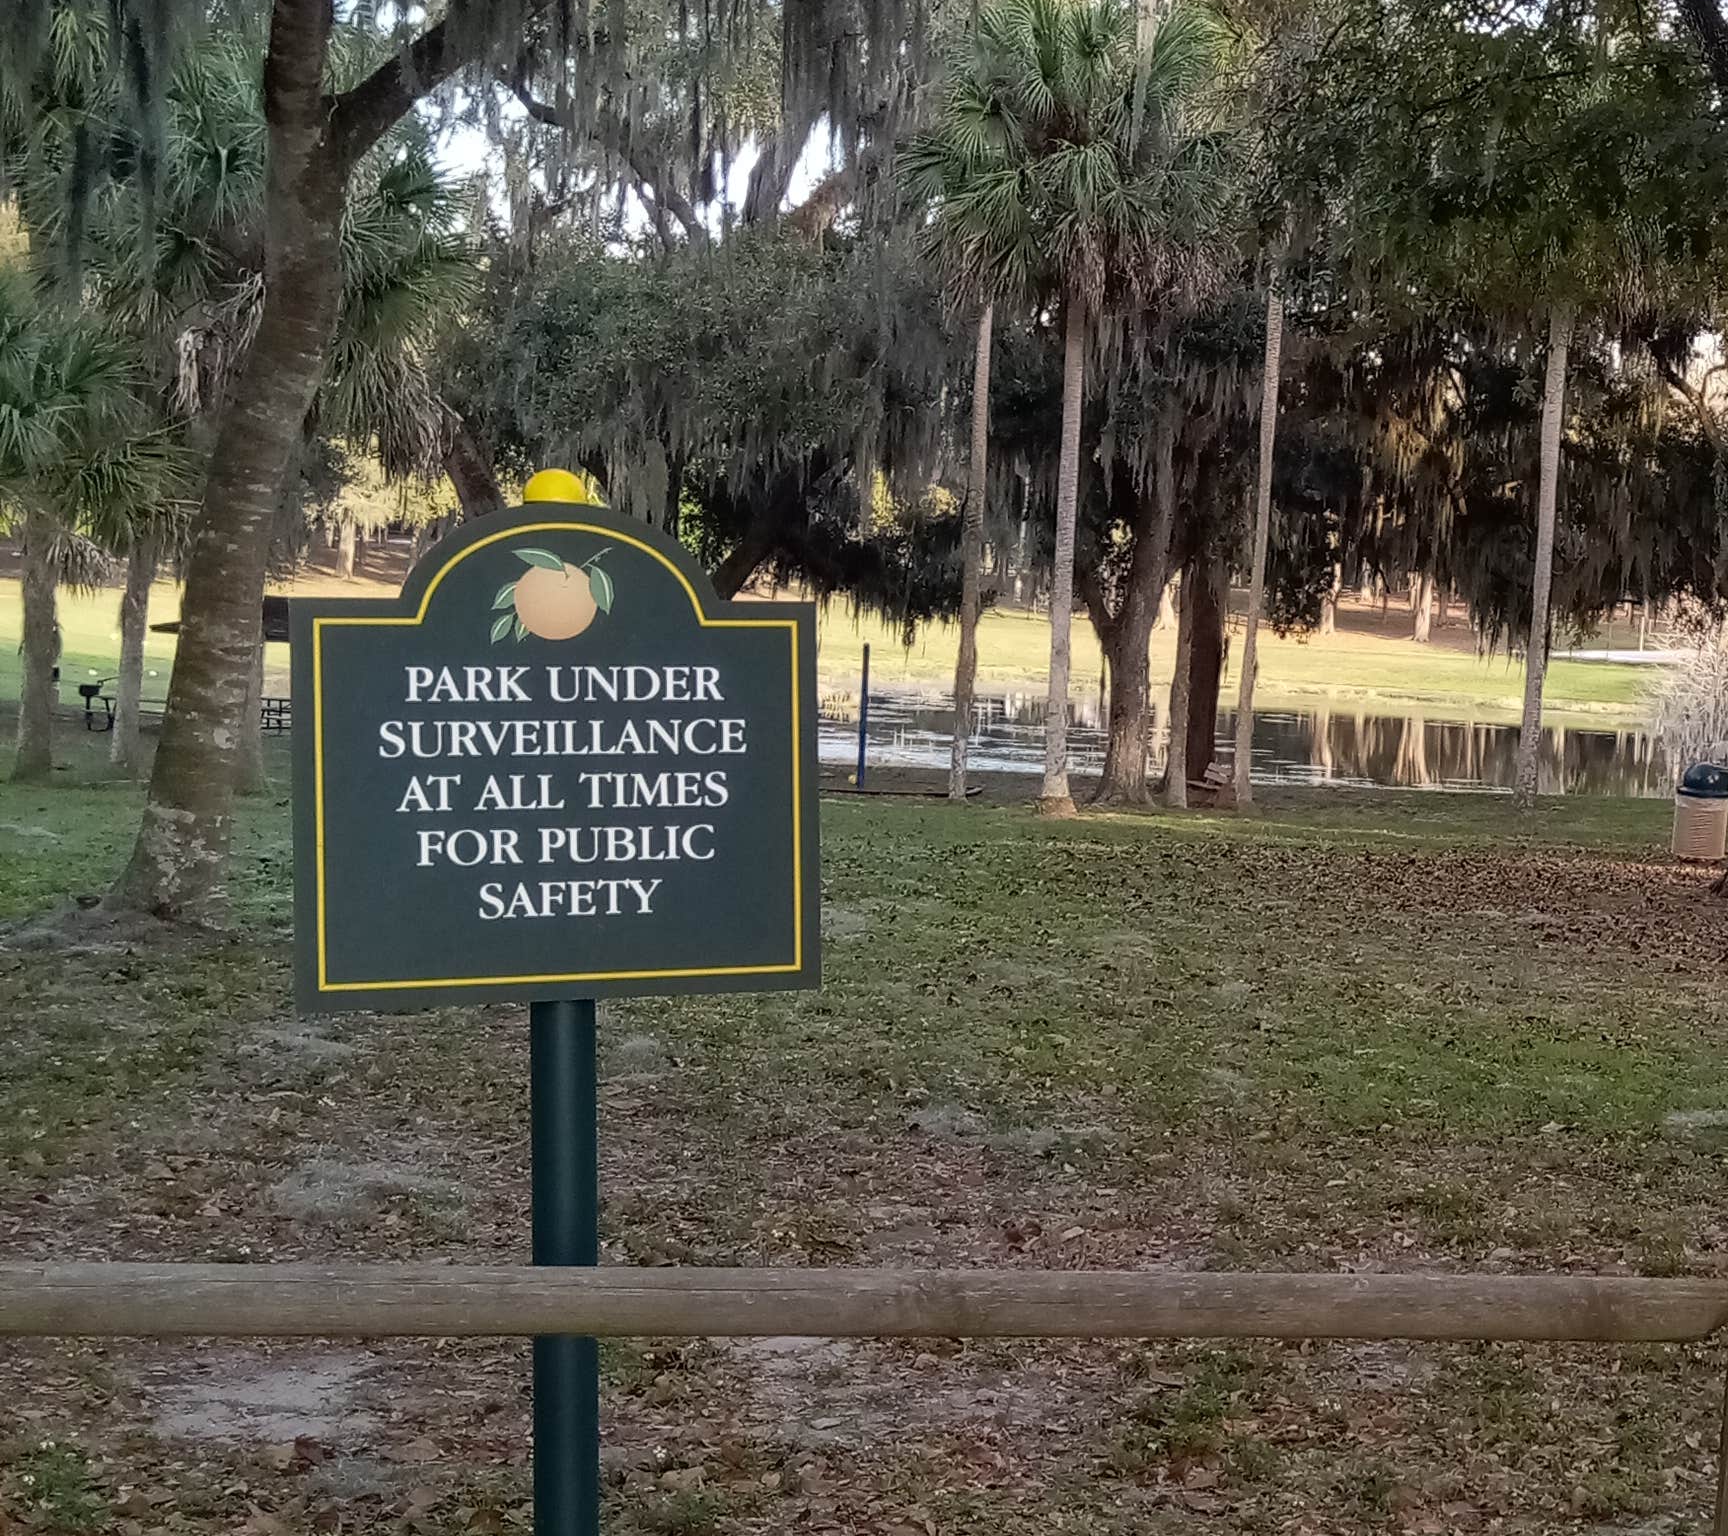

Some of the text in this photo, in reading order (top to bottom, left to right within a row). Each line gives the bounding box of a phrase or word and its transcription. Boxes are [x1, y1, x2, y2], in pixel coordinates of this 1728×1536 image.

[404, 665, 725, 702] PARK UNDER
[379, 718, 747, 758] SURVEILLANCE
[395, 770, 729, 812] AT ALL TIMES
[416, 823, 715, 867] FOR PUBLIC
[479, 878, 663, 920] SAFETY
